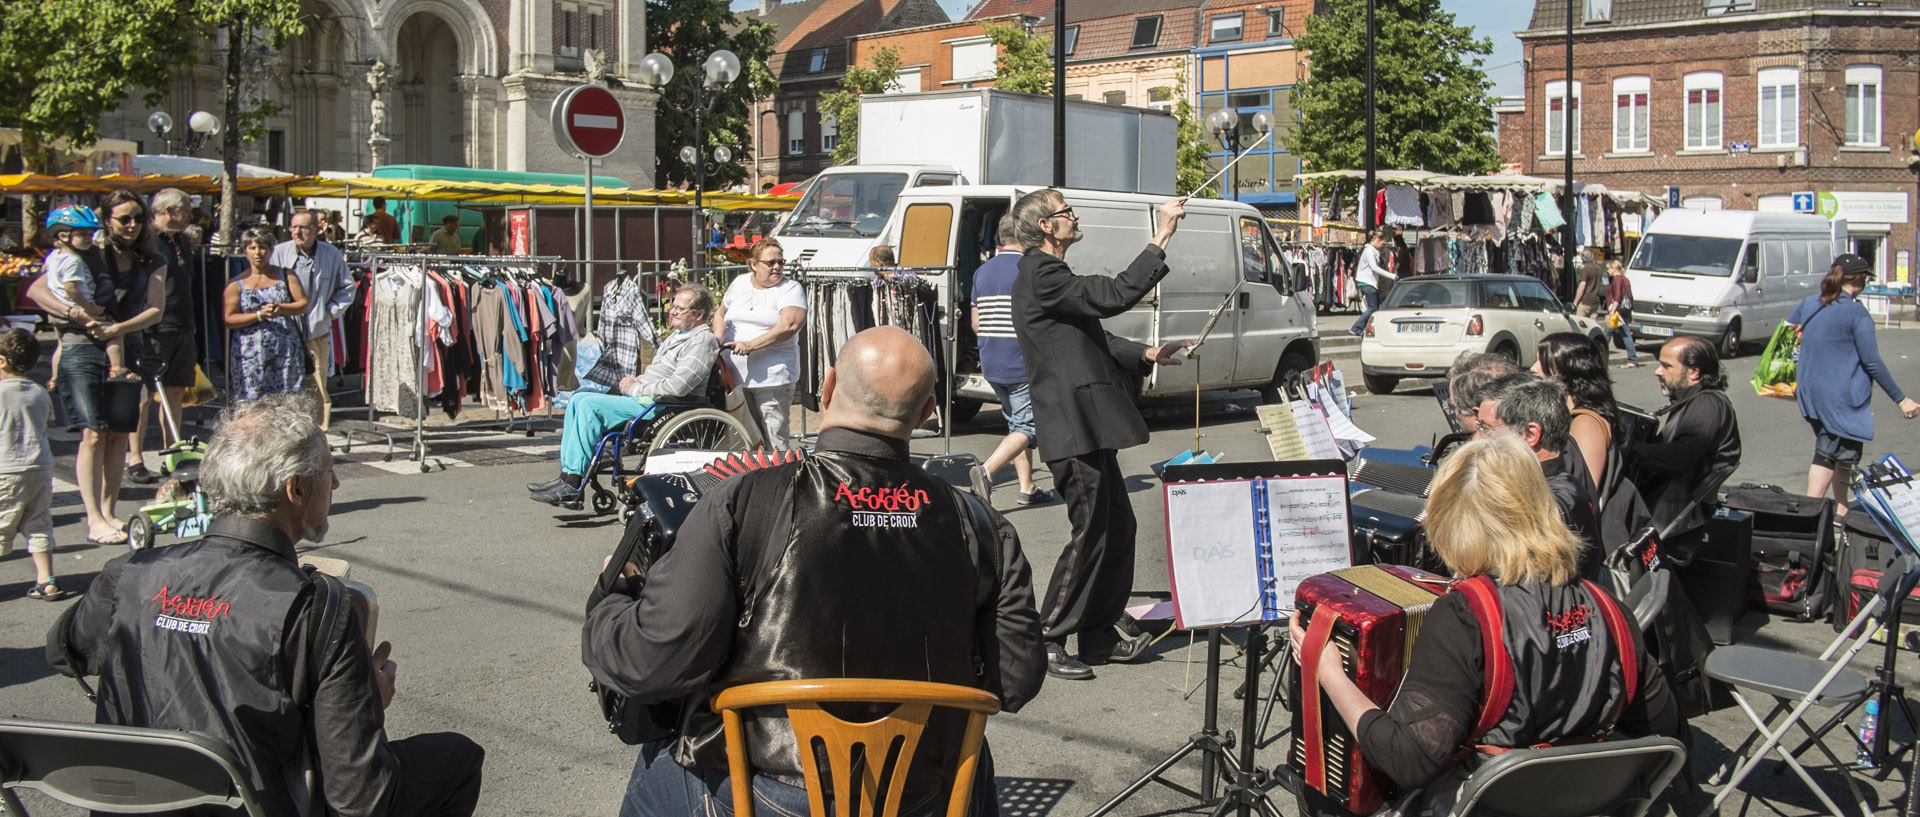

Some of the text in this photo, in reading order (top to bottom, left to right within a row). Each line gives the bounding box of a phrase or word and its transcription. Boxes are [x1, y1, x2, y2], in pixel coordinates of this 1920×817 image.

[1233, 178, 1257, 188] telier
[834, 482, 931, 511] Accordéon
[852, 514, 918, 528] CLUB DE CROIX
[151, 585, 231, 618] Accordéon
[156, 616, 210, 634] CLUB DE CROIX
